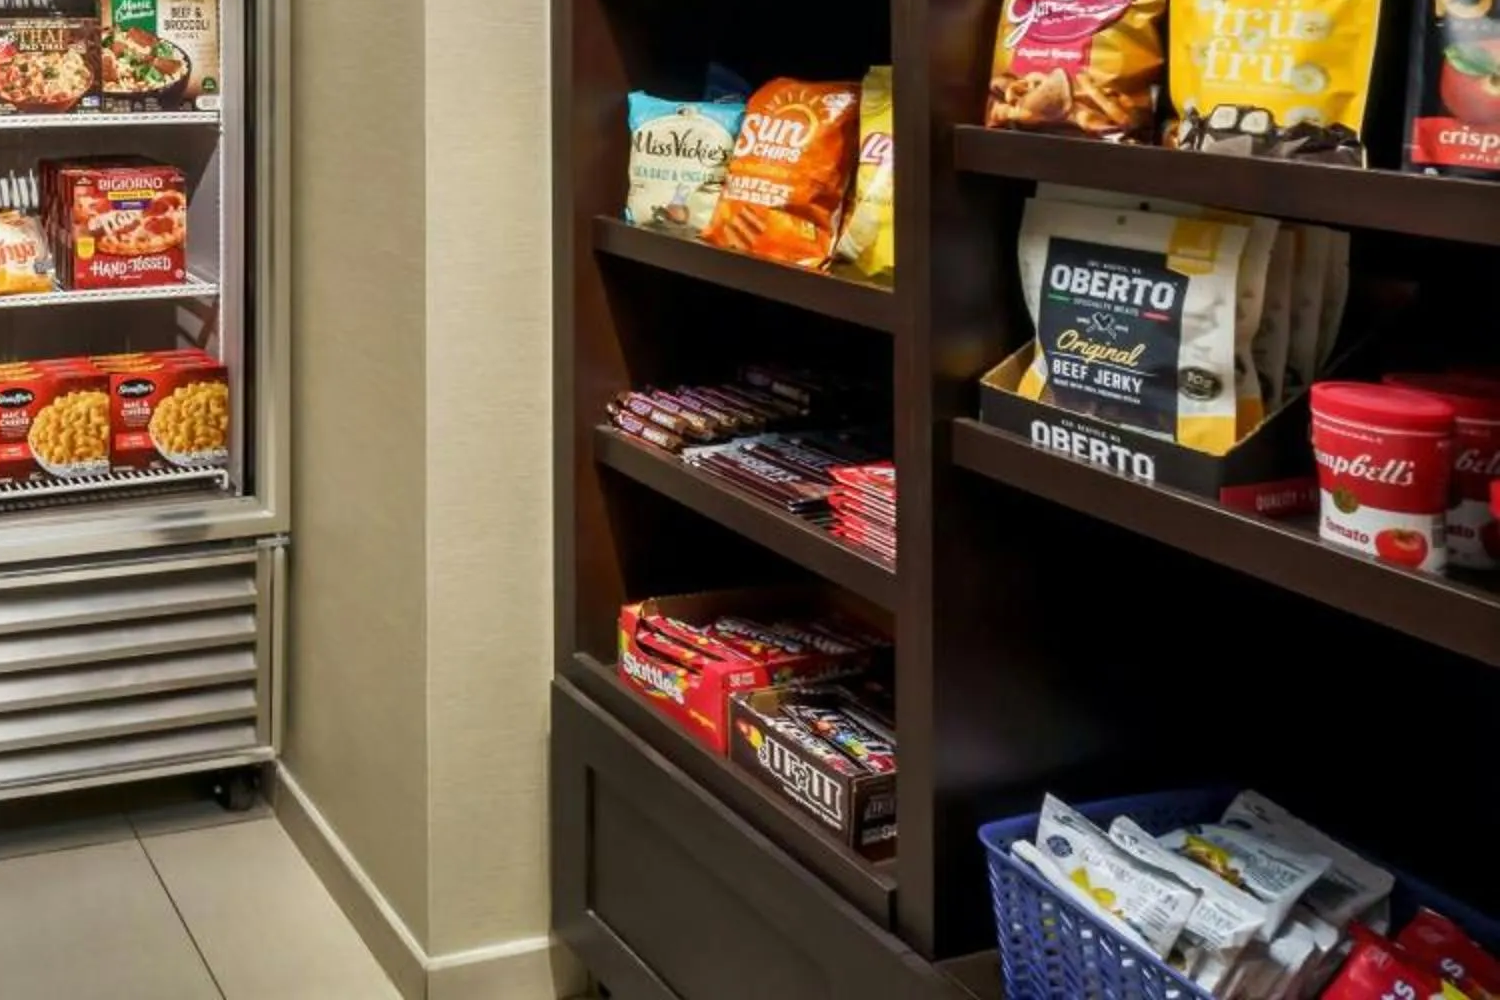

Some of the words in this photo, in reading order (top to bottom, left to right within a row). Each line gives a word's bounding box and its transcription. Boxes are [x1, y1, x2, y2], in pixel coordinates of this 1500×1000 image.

[734, 113, 806, 158] Sun
[753, 143, 802, 163] CHIPS
[1439, 125, 1500, 153] crisp
[1049, 264, 1178, 312] OBERTO
[1056, 328, 1146, 368] Original
[1052, 359, 1090, 381] BEEF
[1093, 367, 1144, 395] JERKY
[1031, 419, 1156, 482] OBERTO
[1315, 449, 1416, 487] mpbell's
[1325, 516, 1370, 545] tomato
[622, 651, 685, 705] Skittles
